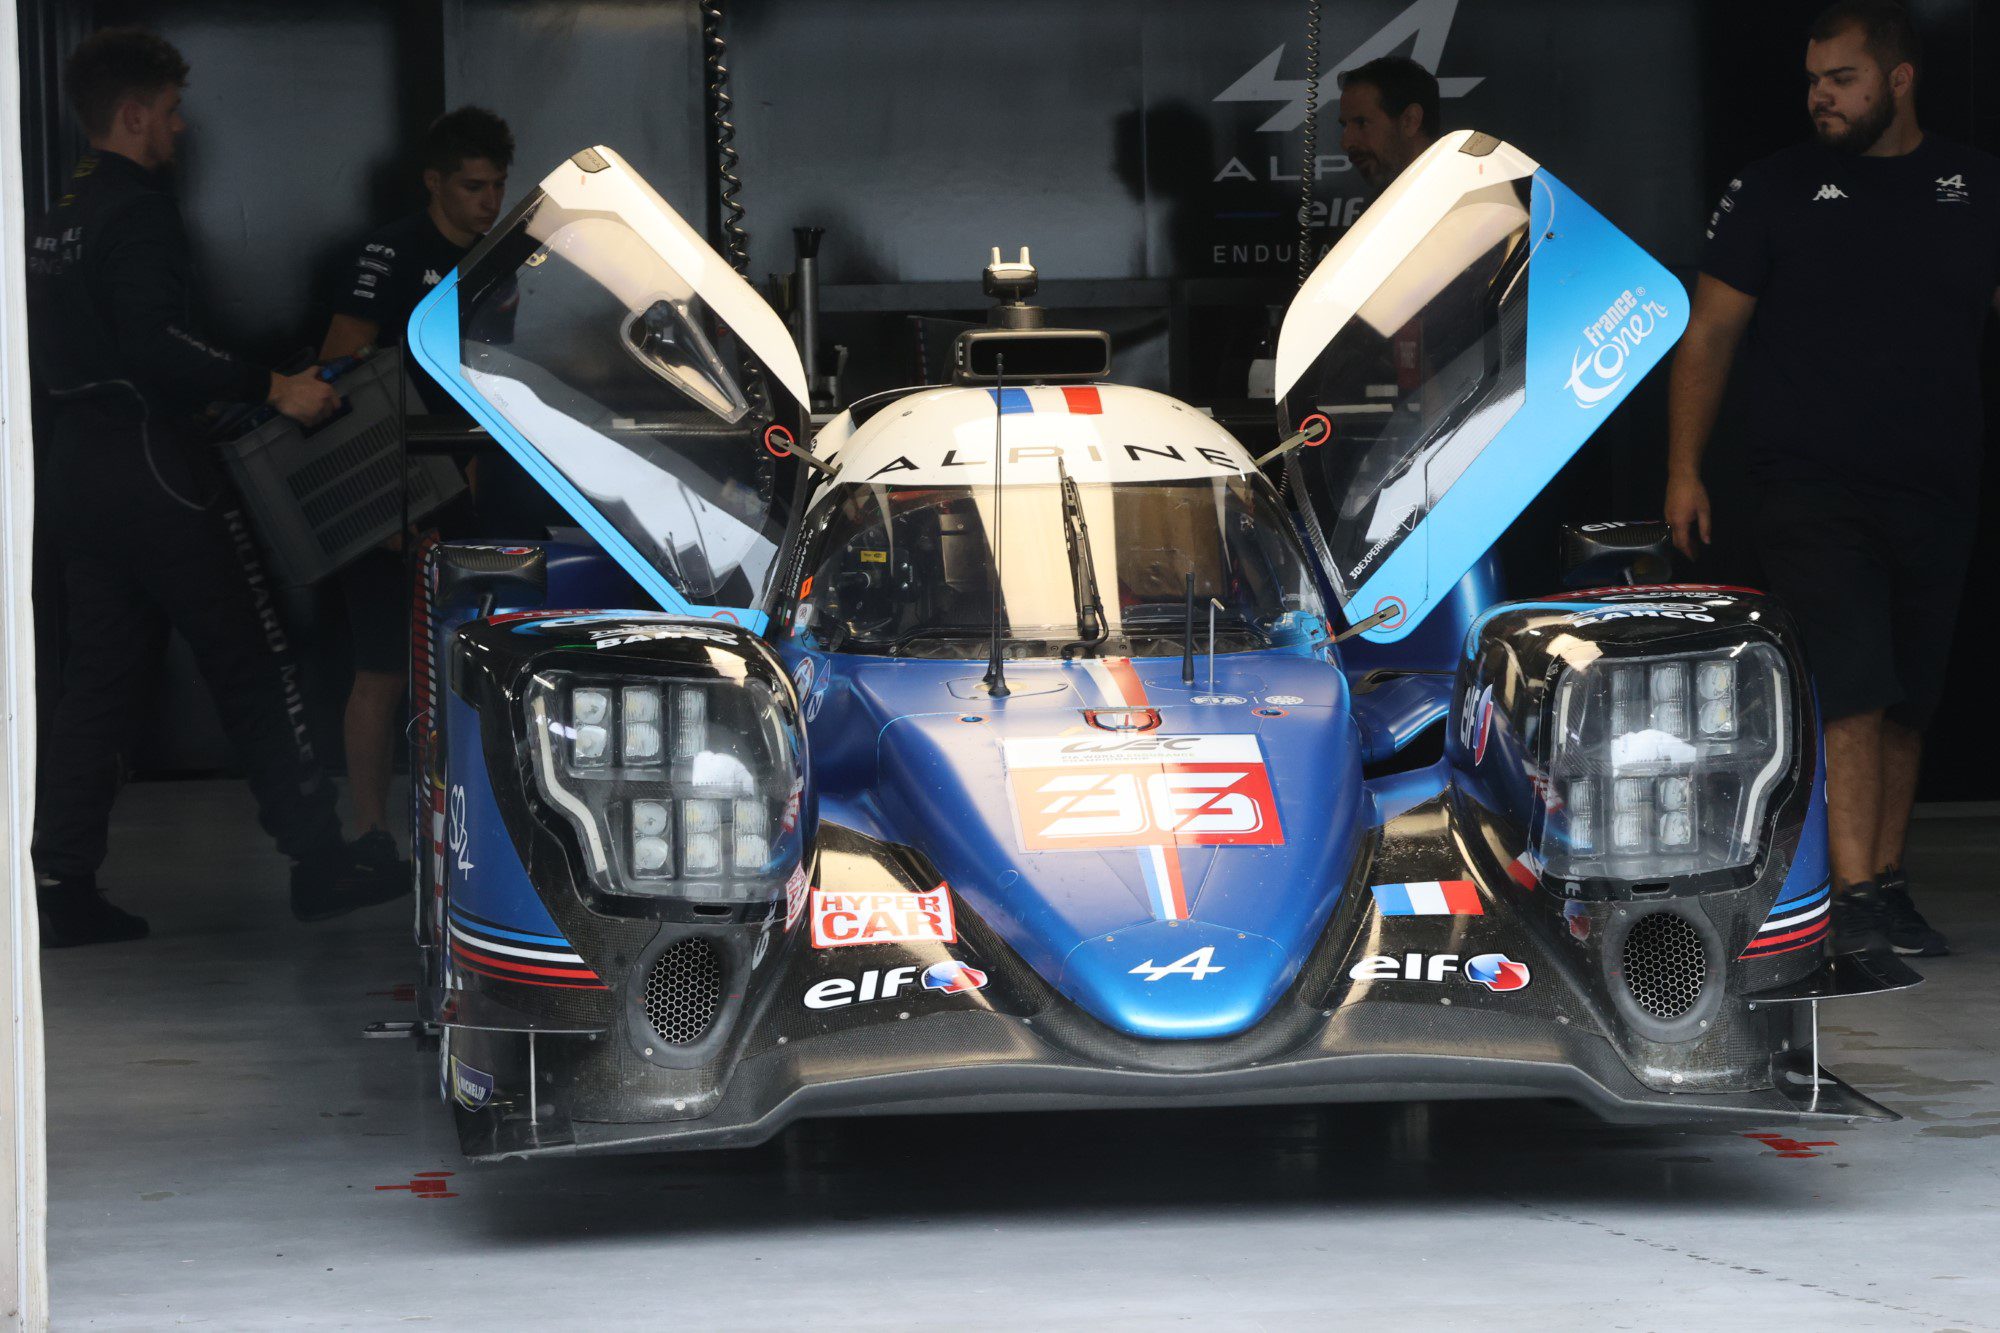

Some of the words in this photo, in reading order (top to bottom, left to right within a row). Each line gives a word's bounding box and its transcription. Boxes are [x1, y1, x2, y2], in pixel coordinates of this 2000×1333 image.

[1213, 156, 1353, 182] ALP
[1297, 197, 1364, 227] elf
[866, 444, 1242, 481] ALPINE
[1349, 525, 1401, 580] 3DEXPERIENCE
[1573, 610, 1715, 628] BAHCO
[596, 632, 739, 650] BAHCO
[1060, 737, 1202, 753] WEC
[1036, 772, 1264, 838] 36
[821, 895, 941, 912] HYPER
[821, 911, 944, 940] CAR
[1349, 953, 1459, 981] elf
[804, 966, 916, 1009] elf
